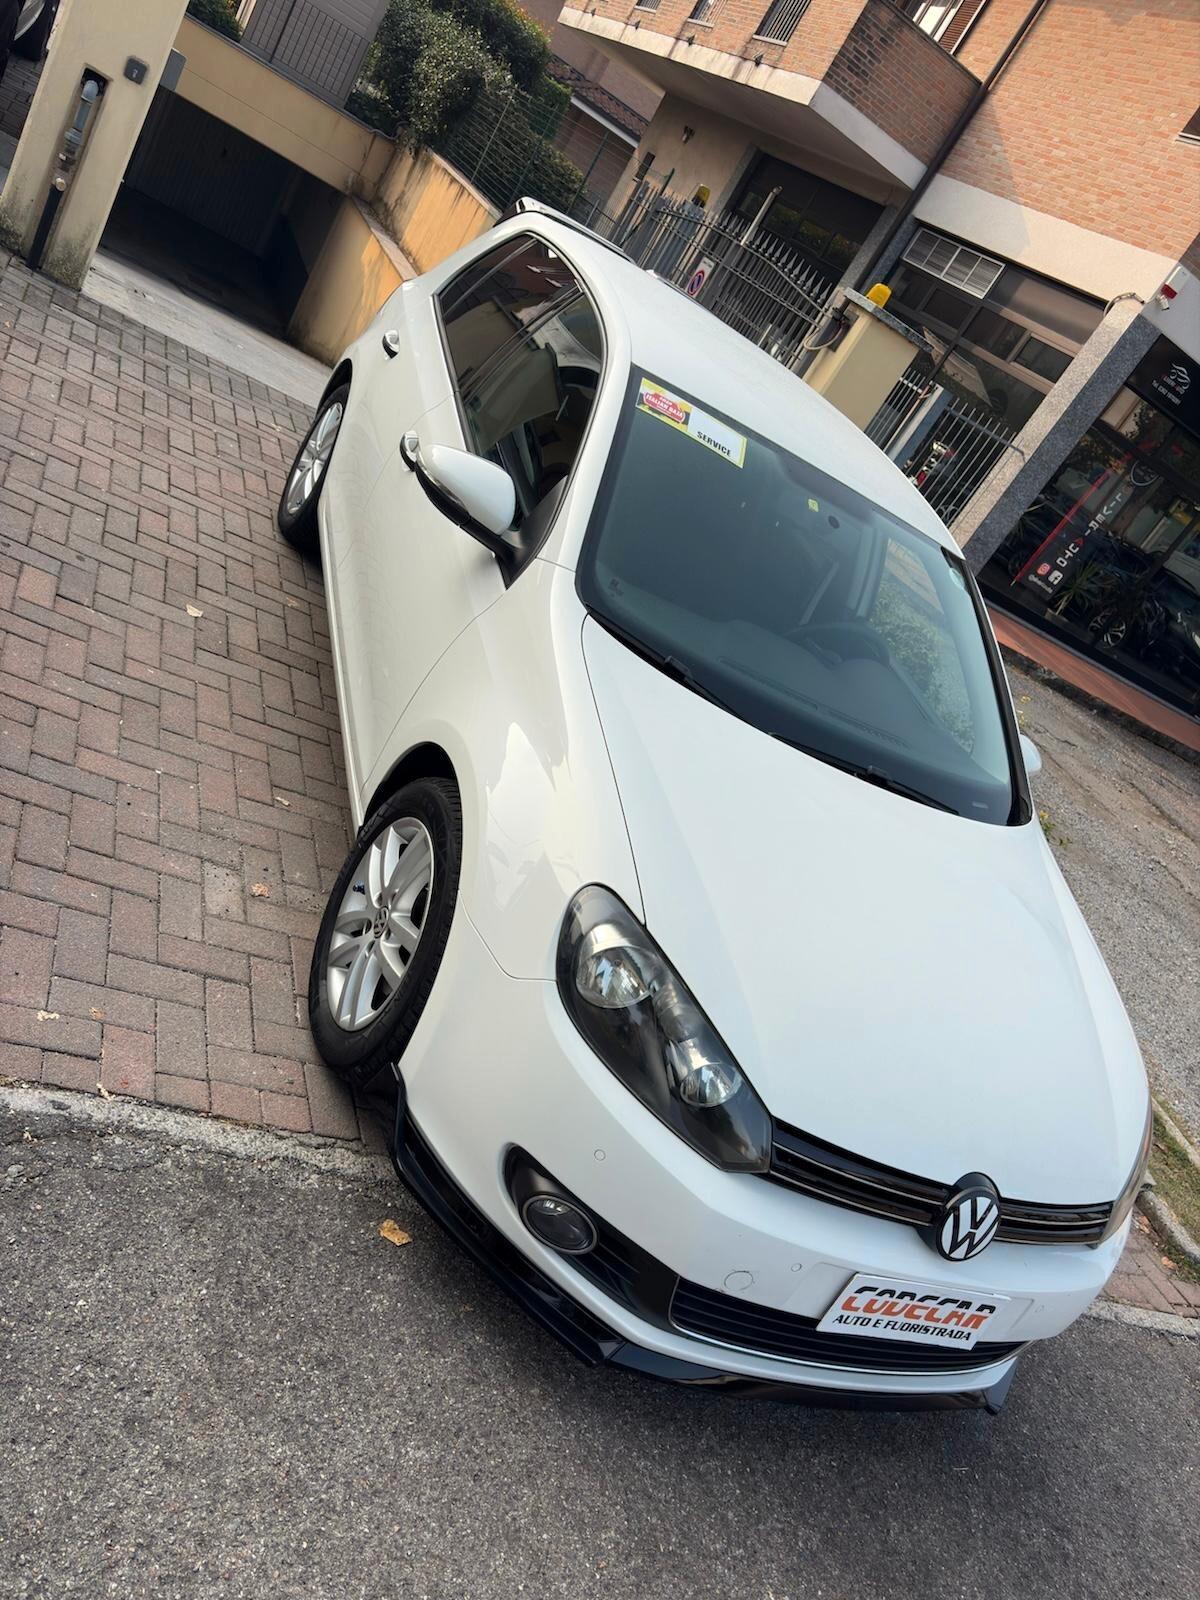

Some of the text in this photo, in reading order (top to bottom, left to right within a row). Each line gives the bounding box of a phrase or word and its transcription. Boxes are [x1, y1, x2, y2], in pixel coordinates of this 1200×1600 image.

[697, 431, 732, 457] SERVICE
[832, 1314, 972, 1341] AUTO E FUORISTRADA
